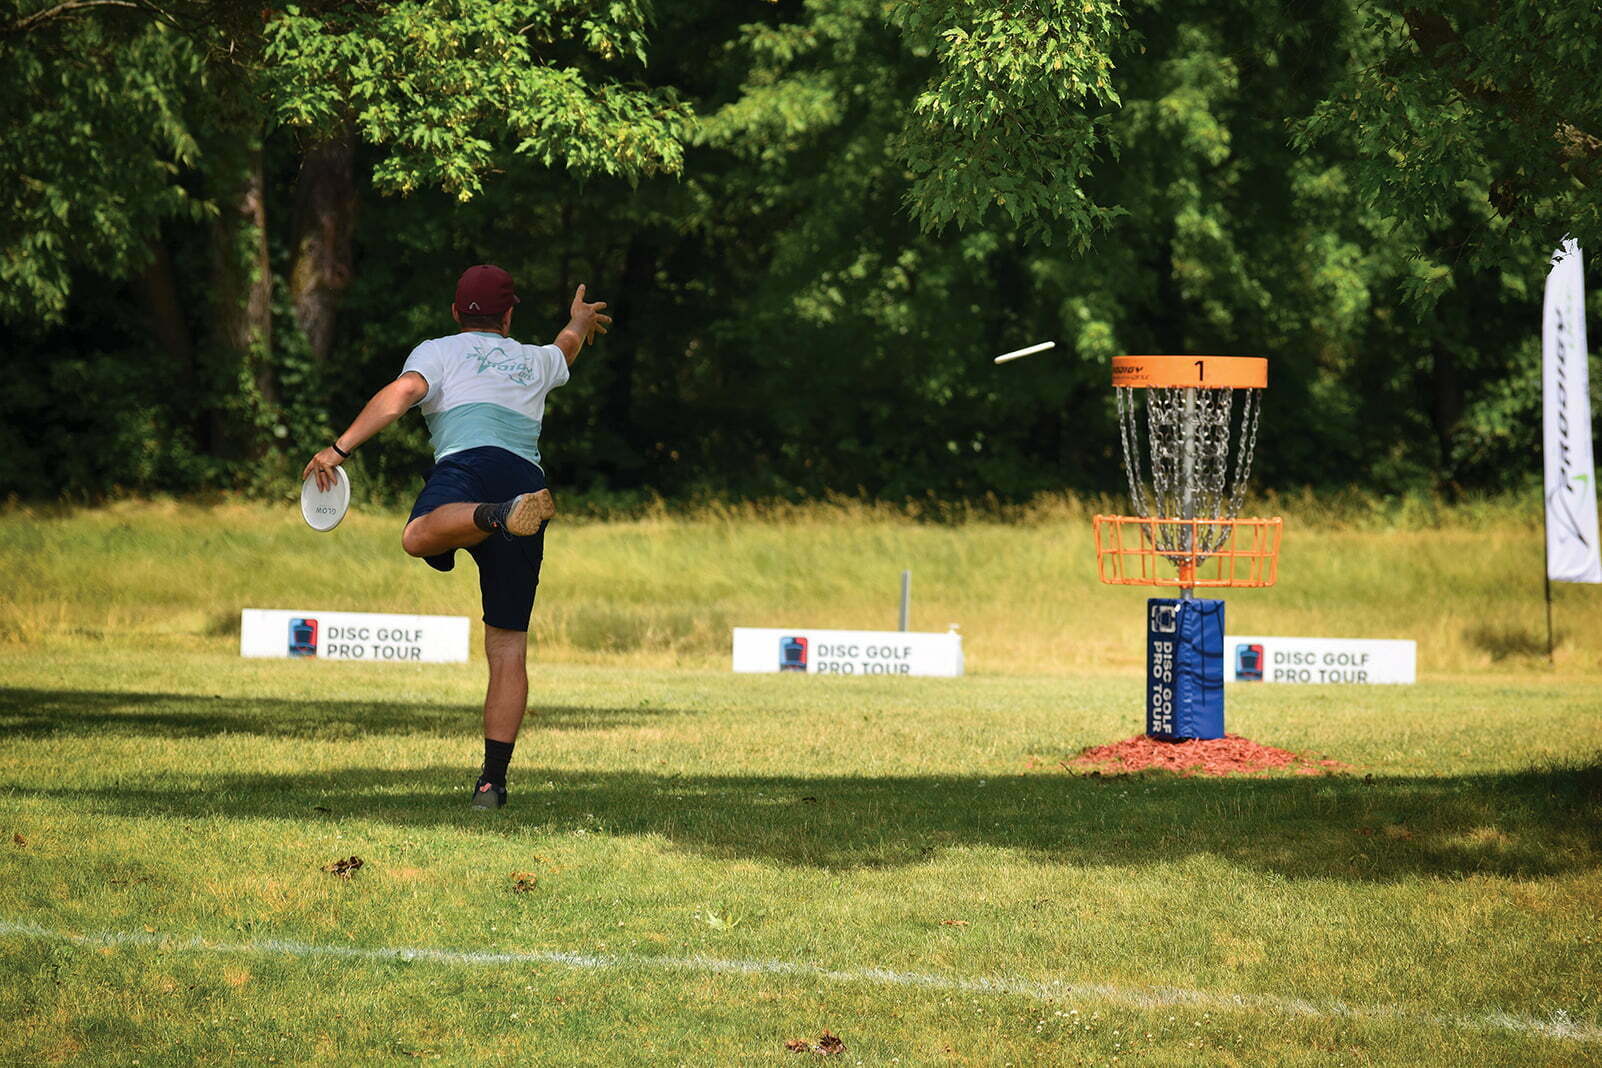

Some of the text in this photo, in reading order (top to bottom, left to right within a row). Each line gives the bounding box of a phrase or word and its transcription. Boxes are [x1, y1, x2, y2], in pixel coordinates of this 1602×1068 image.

[1194, 360, 1204, 381] 1
[316, 507, 337, 515] GLOW
[327, 627, 423, 642] DISC GOLF
[327, 644, 422, 660] PRO TOUR
[817, 644, 913, 660] DISC GOLF
[1274, 651, 1370, 666] DISC GOLF
[817, 662, 911, 675] PRO TOUR
[1274, 669, 1369, 684] PRO TOUR
[1153, 641, 1163, 732] PRO TOUR
[1163, 641, 1172, 733] DISC GOLF
